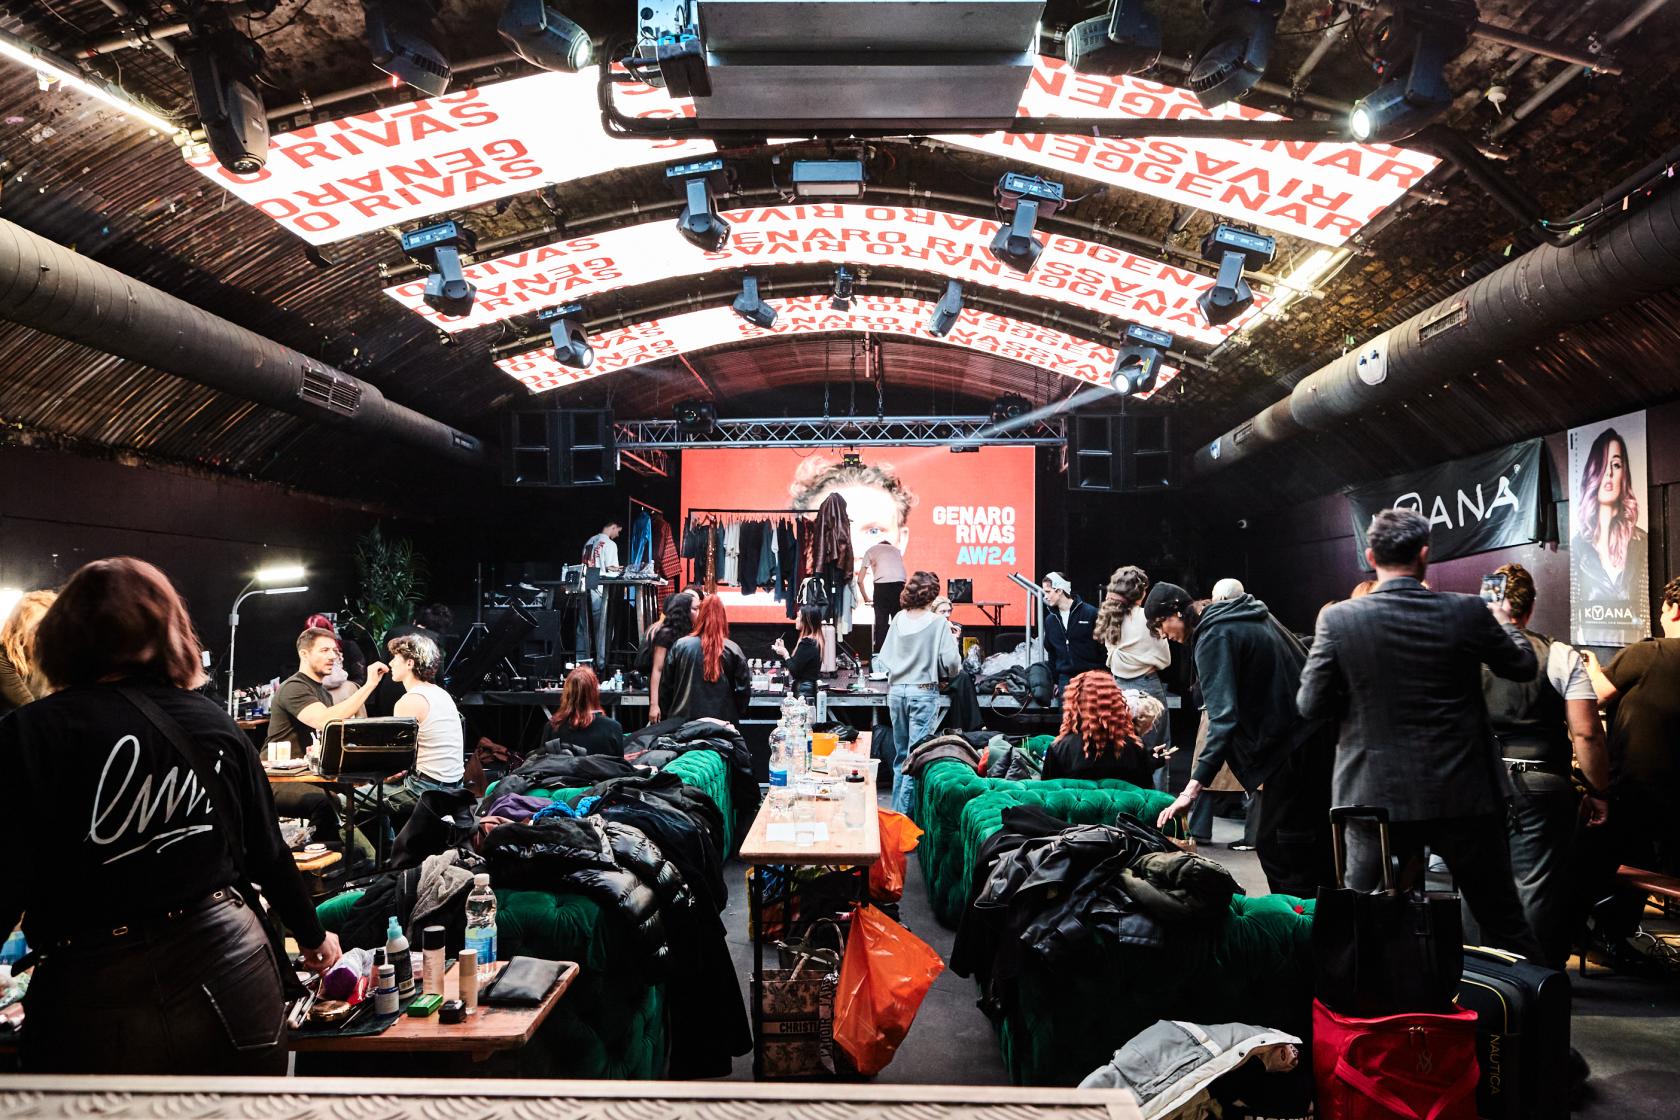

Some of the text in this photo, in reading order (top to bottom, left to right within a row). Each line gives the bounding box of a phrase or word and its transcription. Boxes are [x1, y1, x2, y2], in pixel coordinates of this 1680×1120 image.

[281, 102, 500, 169] RIVAS
[253, 138, 529, 220] GENARO
[1144, 141, 1353, 212] RIVAS
[350, 158, 543, 218] RIVAS
[720, 205, 844, 224] RIVA
[731, 227, 907, 246] ENARO
[703, 240, 847, 261] RIVAS
[480, 267, 623, 312] RIVAS
[1373, 475, 1519, 534] ANA
[932, 505, 1016, 526] GENARO
[955, 524, 1016, 544] RIVAS
[955, 545, 1017, 566] AW24
[1584, 605, 1633, 621] KYANA
[779, 1022, 821, 1034] CHRISTI
[1488, 1033, 1501, 1096] NAUTICA
